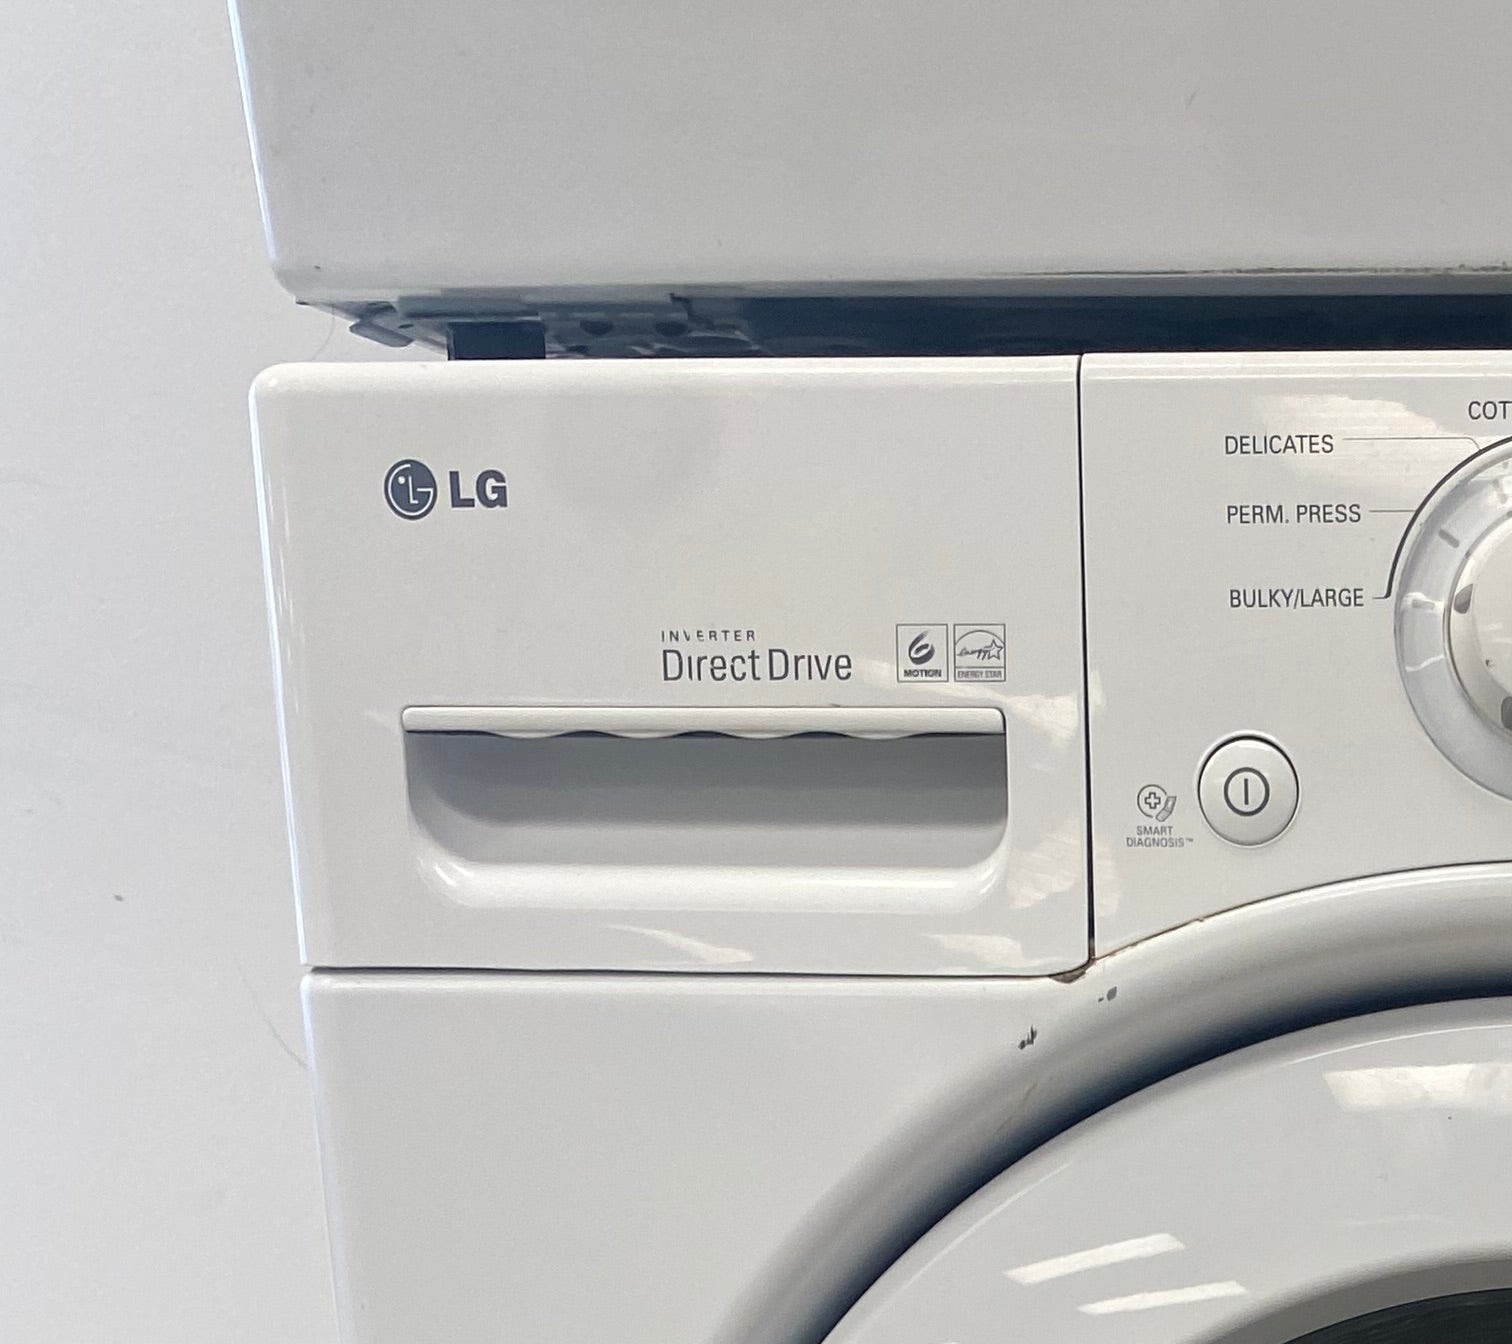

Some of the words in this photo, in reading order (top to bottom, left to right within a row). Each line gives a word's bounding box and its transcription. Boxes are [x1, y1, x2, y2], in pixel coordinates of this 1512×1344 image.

[1224, 433, 1334, 455] DELICATES
[448, 469, 508, 509] LG
[1227, 504, 1290, 525] PERM.
[1296, 503, 1361, 524] PRESS
[1229, 587, 1364, 610] BULKY/LARGE
[661, 629, 756, 643] INVERTER
[903, 668, 942, 678] MOTION
[1136, 825, 1174, 836] SMART
